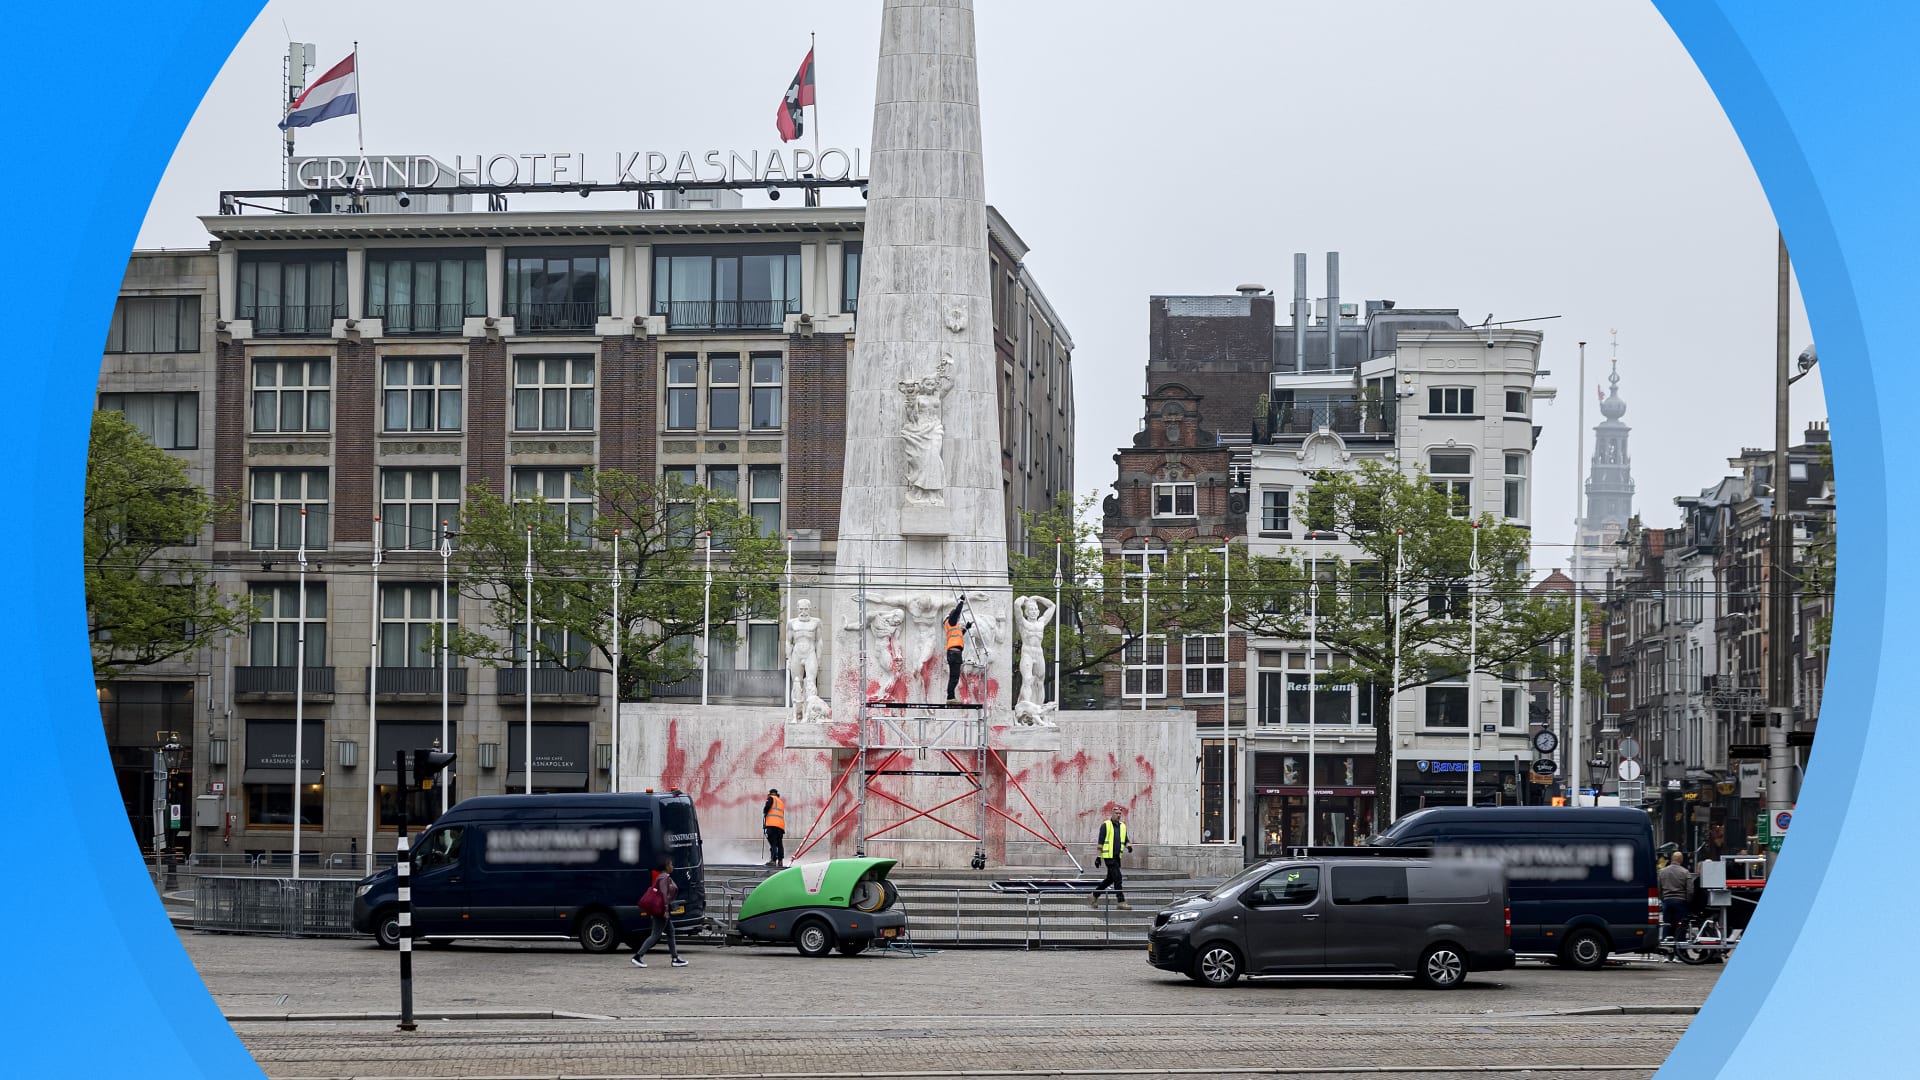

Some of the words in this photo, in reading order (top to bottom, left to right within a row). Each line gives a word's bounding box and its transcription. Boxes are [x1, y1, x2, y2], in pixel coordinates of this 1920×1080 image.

[297, 156, 439, 190] GRAND
[456, 152, 598, 187] HOTEL
[1431, 761, 1481, 773] Bavara
